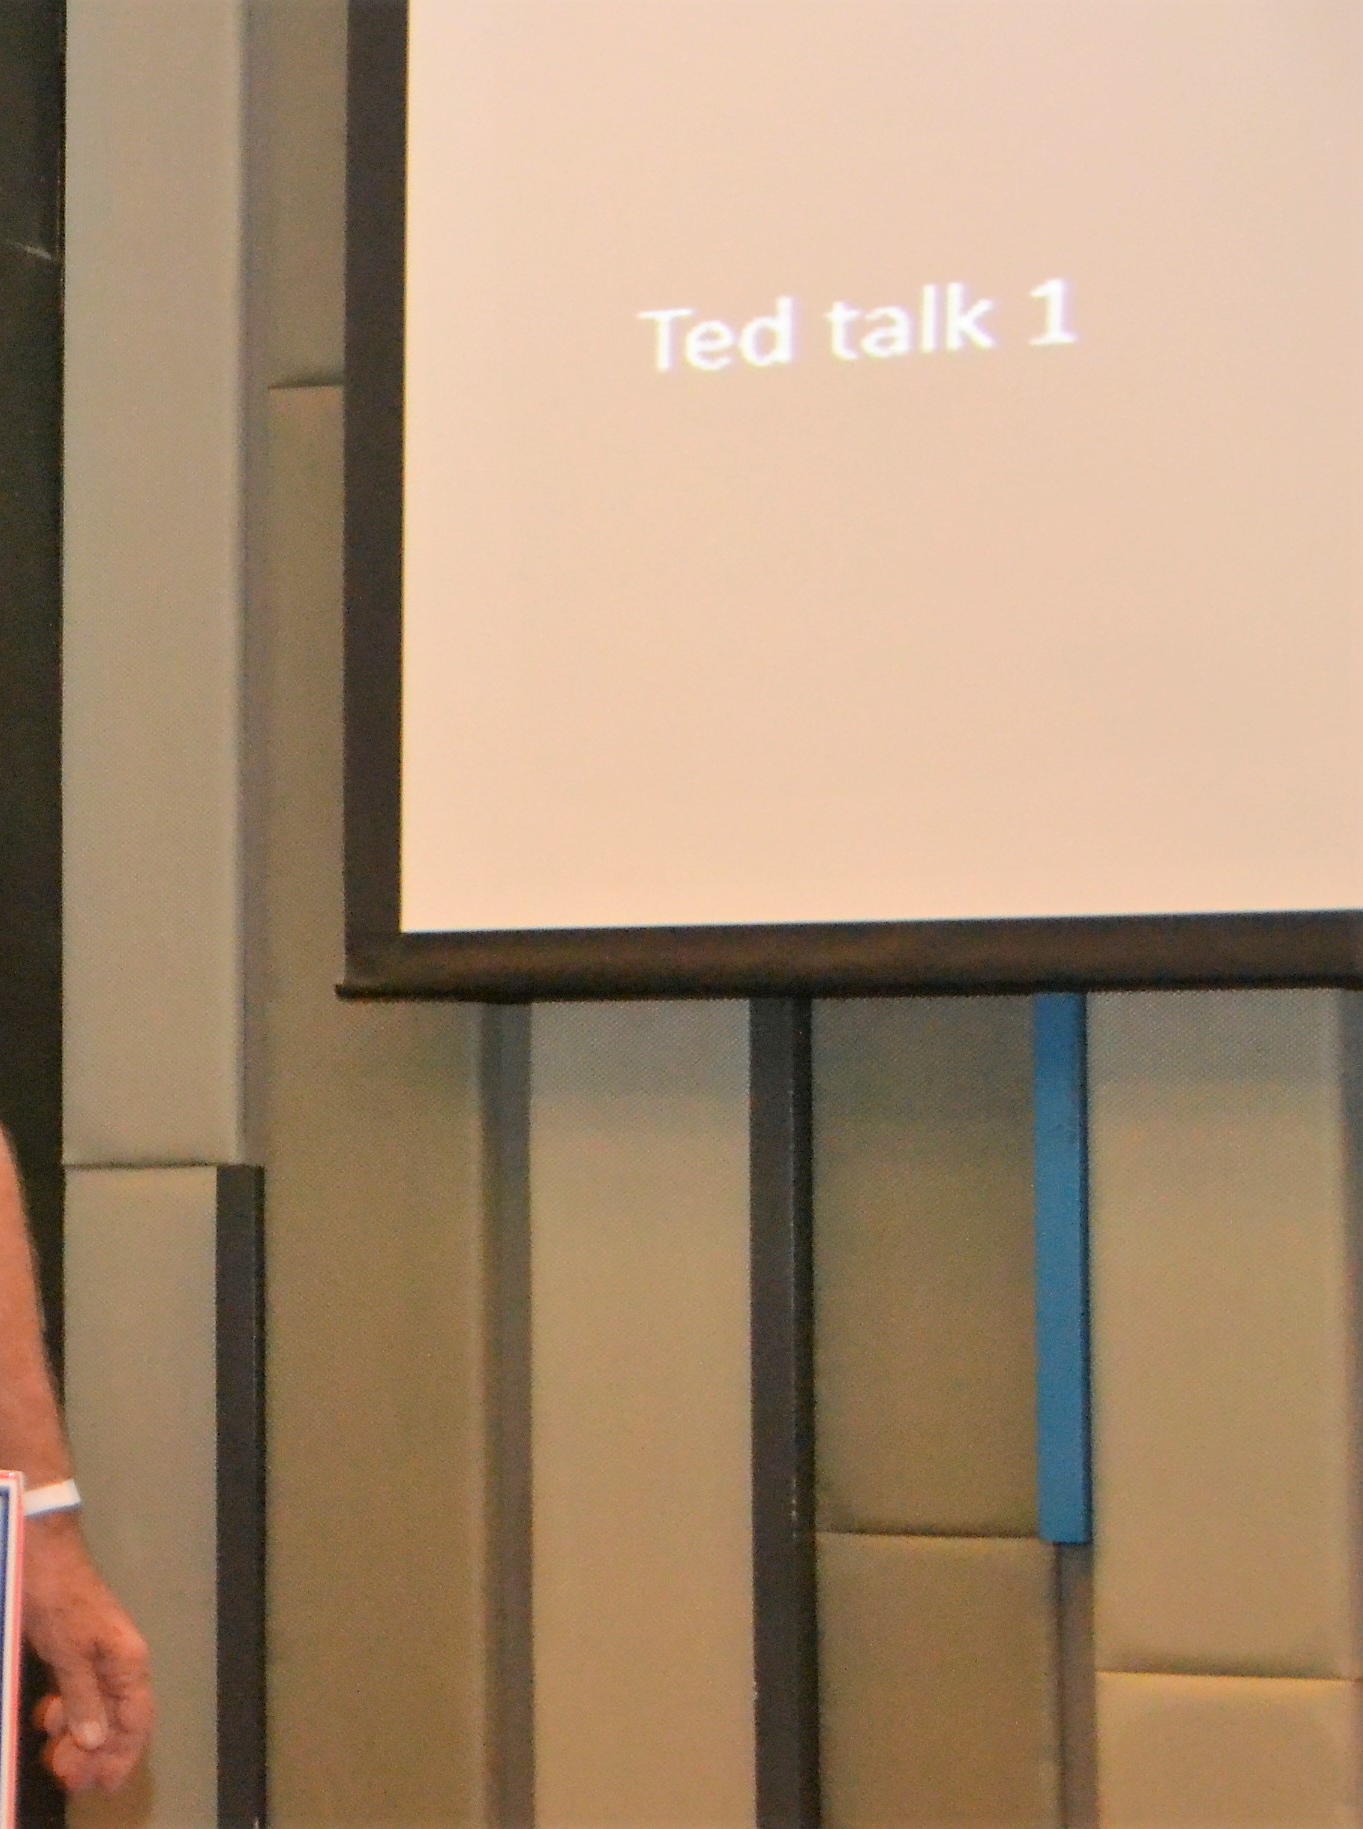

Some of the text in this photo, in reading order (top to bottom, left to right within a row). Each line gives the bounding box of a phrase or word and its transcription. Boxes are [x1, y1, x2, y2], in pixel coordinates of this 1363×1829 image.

[636, 277, 1077, 372] Ted talk 1
